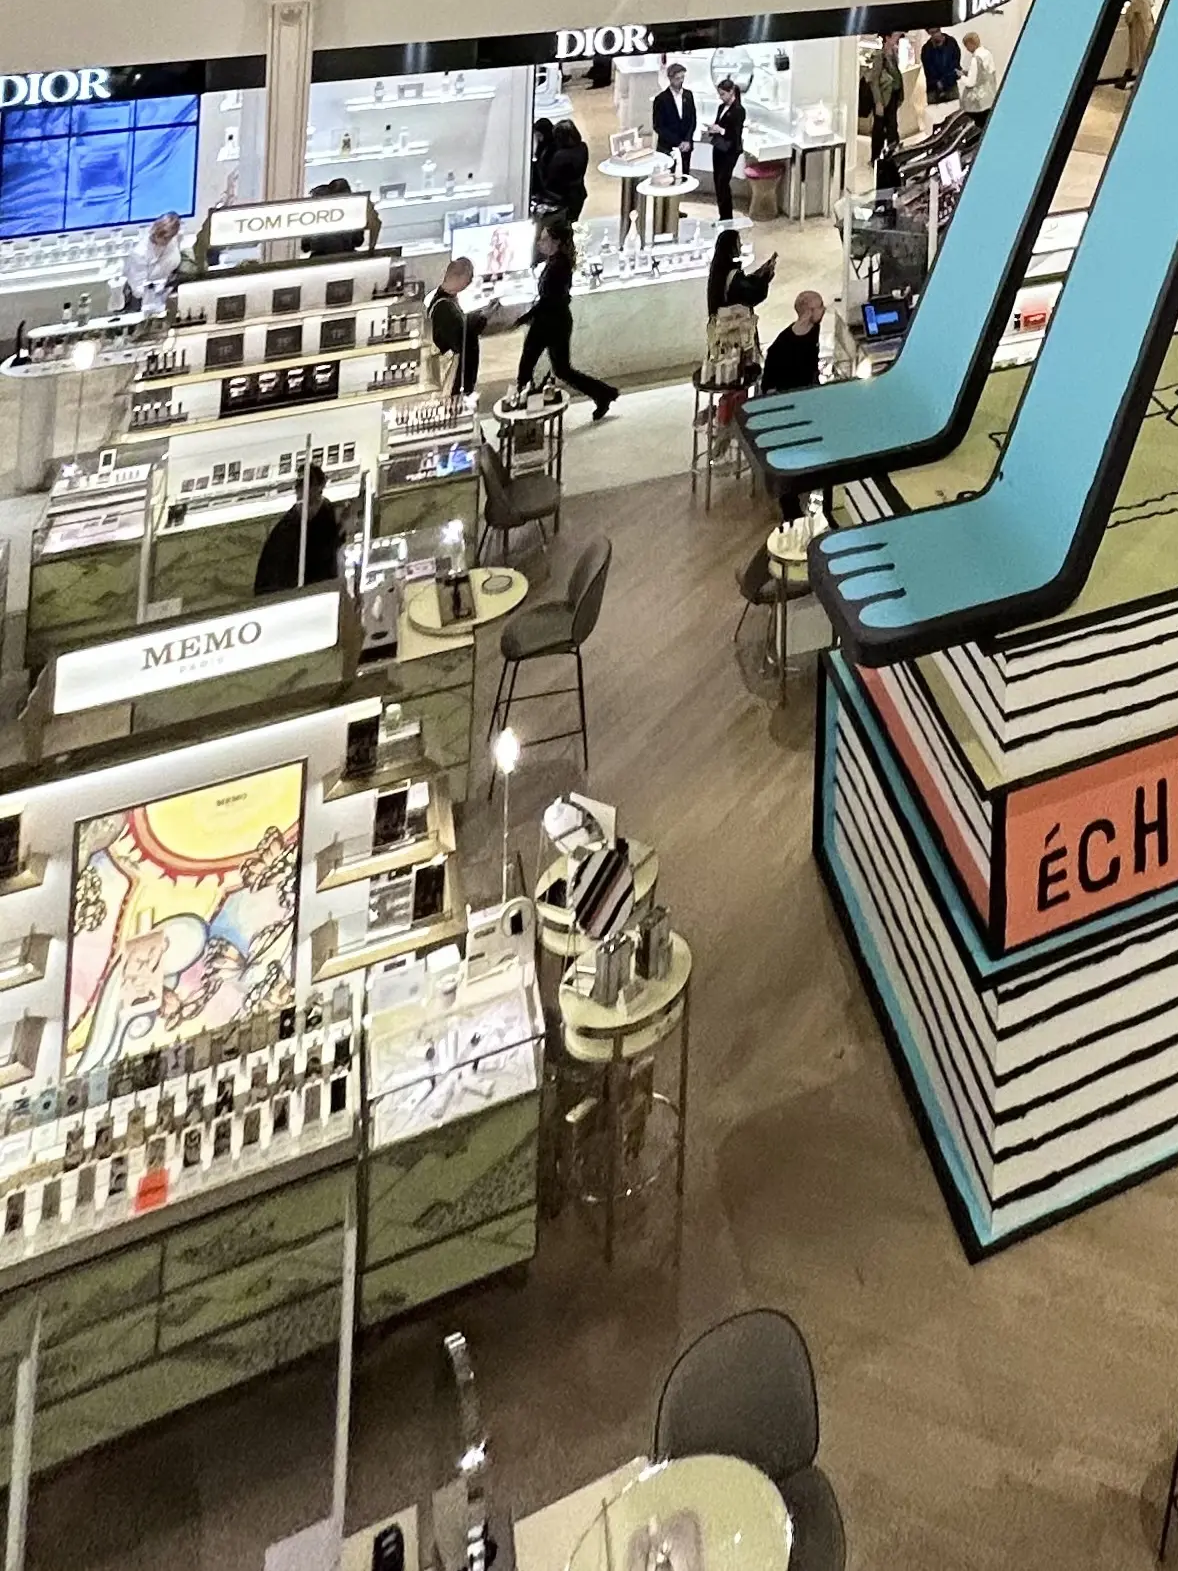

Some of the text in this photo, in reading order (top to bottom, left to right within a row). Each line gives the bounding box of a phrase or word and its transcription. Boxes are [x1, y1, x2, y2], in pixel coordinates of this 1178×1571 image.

[555, 24, 649, 59] DIOR
[0, 68, 112, 108] DIOR
[234, 208, 345, 234] TOM FORD
[140, 620, 263, 671] MEMO
